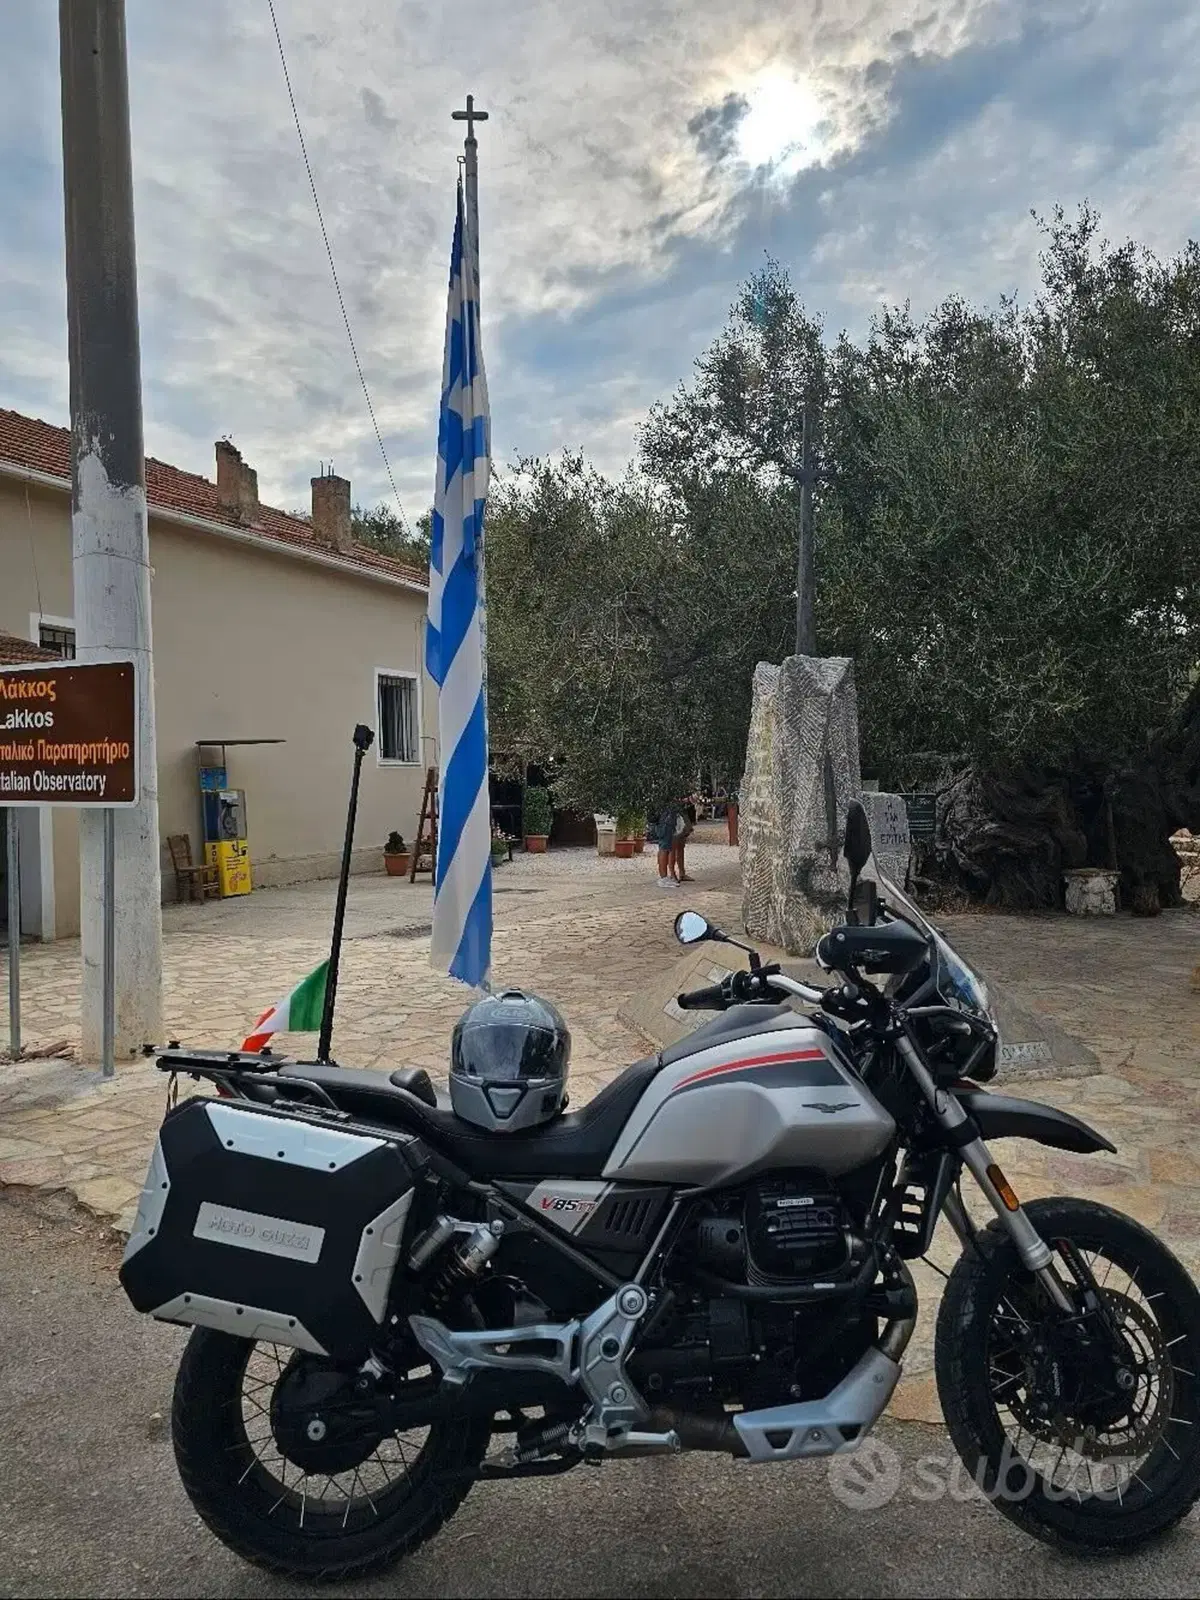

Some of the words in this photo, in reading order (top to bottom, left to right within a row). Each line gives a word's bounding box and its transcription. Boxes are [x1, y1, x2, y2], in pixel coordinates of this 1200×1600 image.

[0, 709, 54, 729] akkos
[37, 737, 130, 765] Παρατηρητήριο
[33, 769, 106, 796] Observatory
[208, 1213, 256, 1238] MOTO
